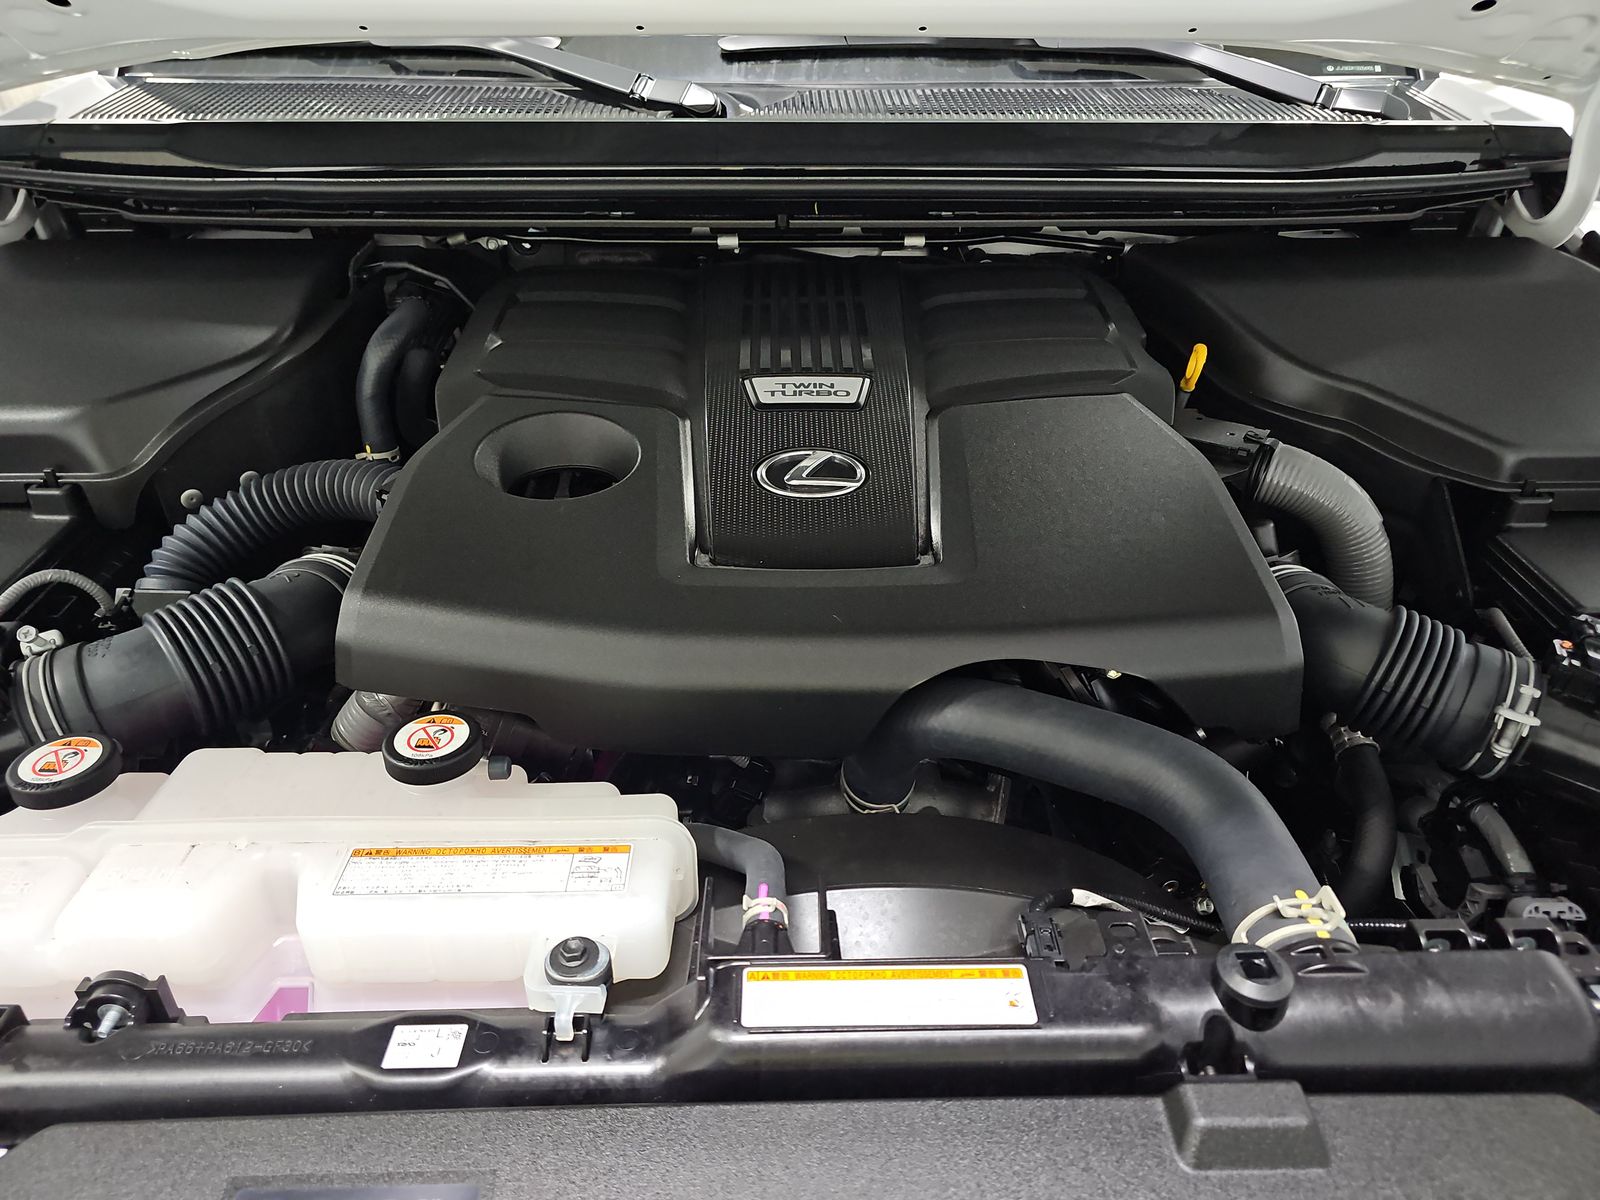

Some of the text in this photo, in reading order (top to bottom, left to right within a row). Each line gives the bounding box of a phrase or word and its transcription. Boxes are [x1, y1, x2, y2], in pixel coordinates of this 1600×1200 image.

[763, 389, 851, 397] TURBO
[395, 848, 431, 856] WARNING
[490, 846, 552, 855] AVERTISSEMENT
[795, 971, 831, 980] WARNING
